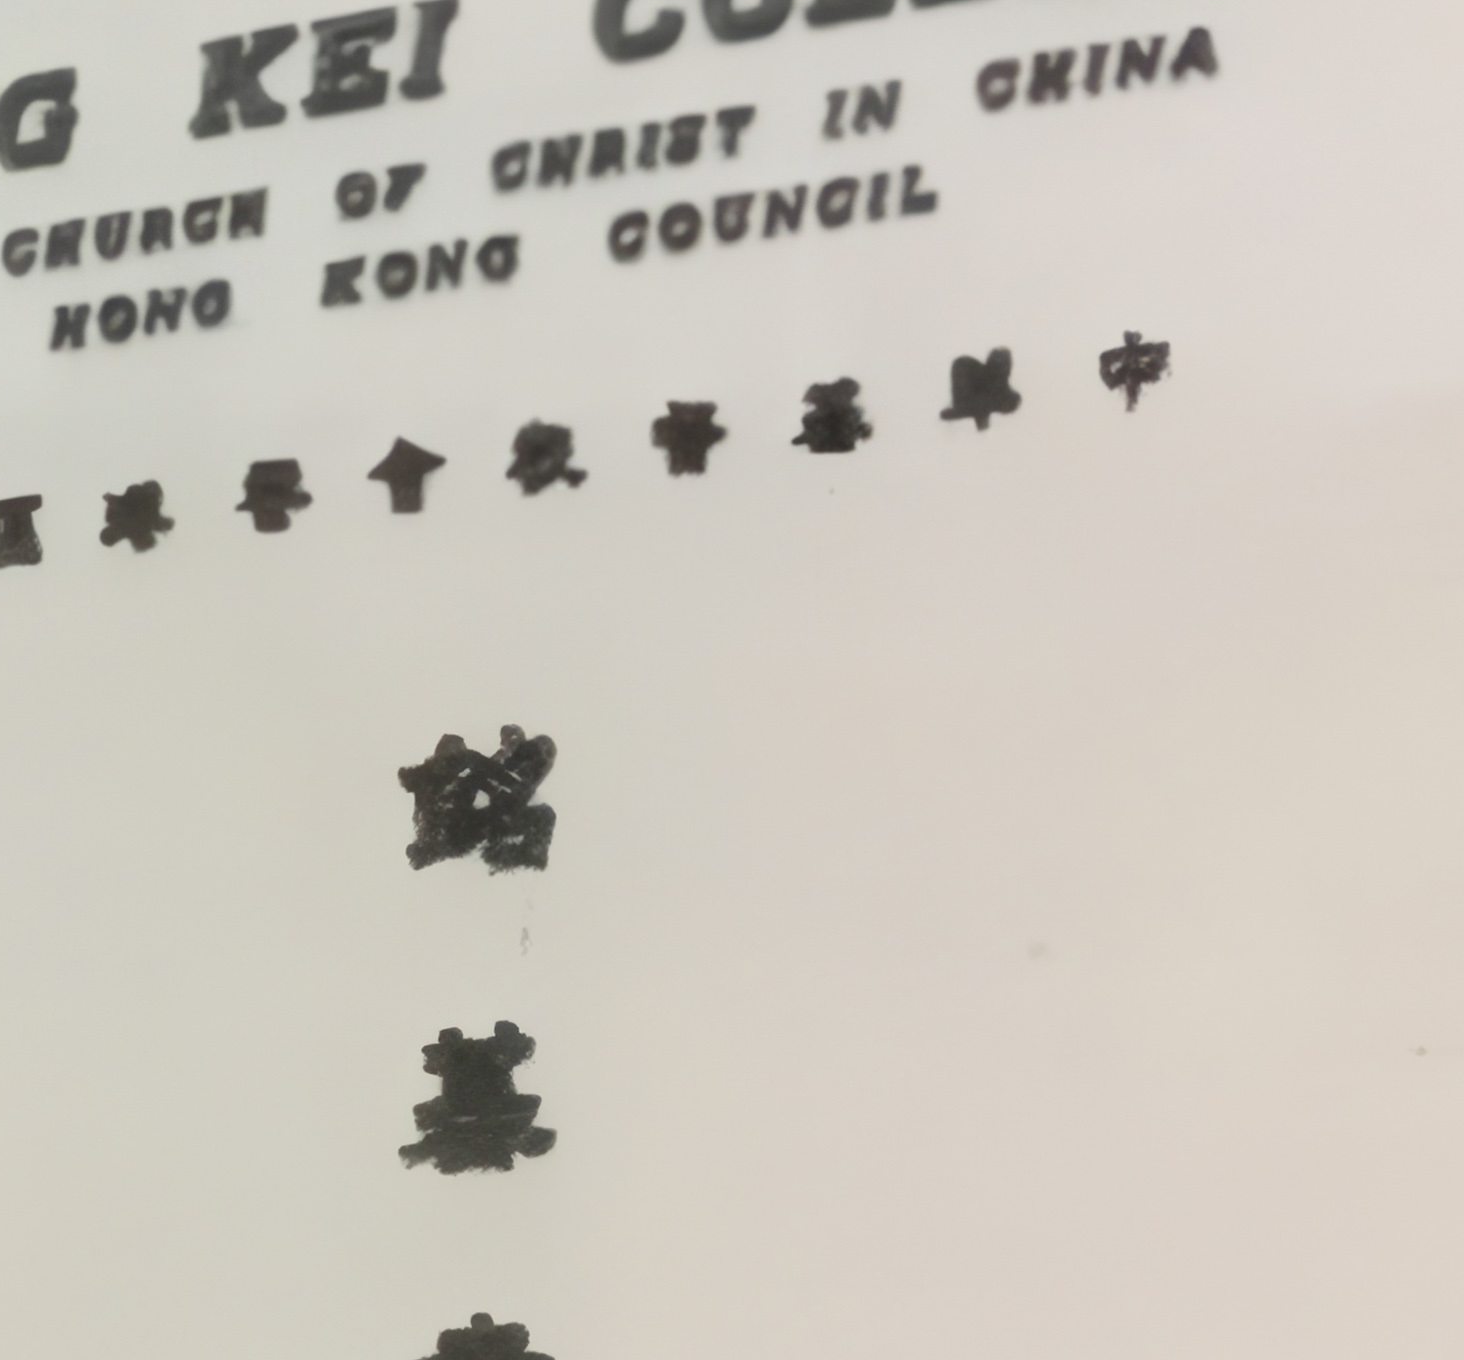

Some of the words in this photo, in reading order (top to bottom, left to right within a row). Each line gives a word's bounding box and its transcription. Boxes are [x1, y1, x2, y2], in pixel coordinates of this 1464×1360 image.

[2, 189, 267, 277] CHURCH
[336, 164, 425, 220] OF
[491, 106, 755, 193] CHRIST
[824, 81, 901, 139] IN
[976, 27, 1219, 113] CHINA
[49, 279, 231, 352] HONG
[320, 235, 519, 308] KONG
[608, 165, 939, 264] COUNCIL
